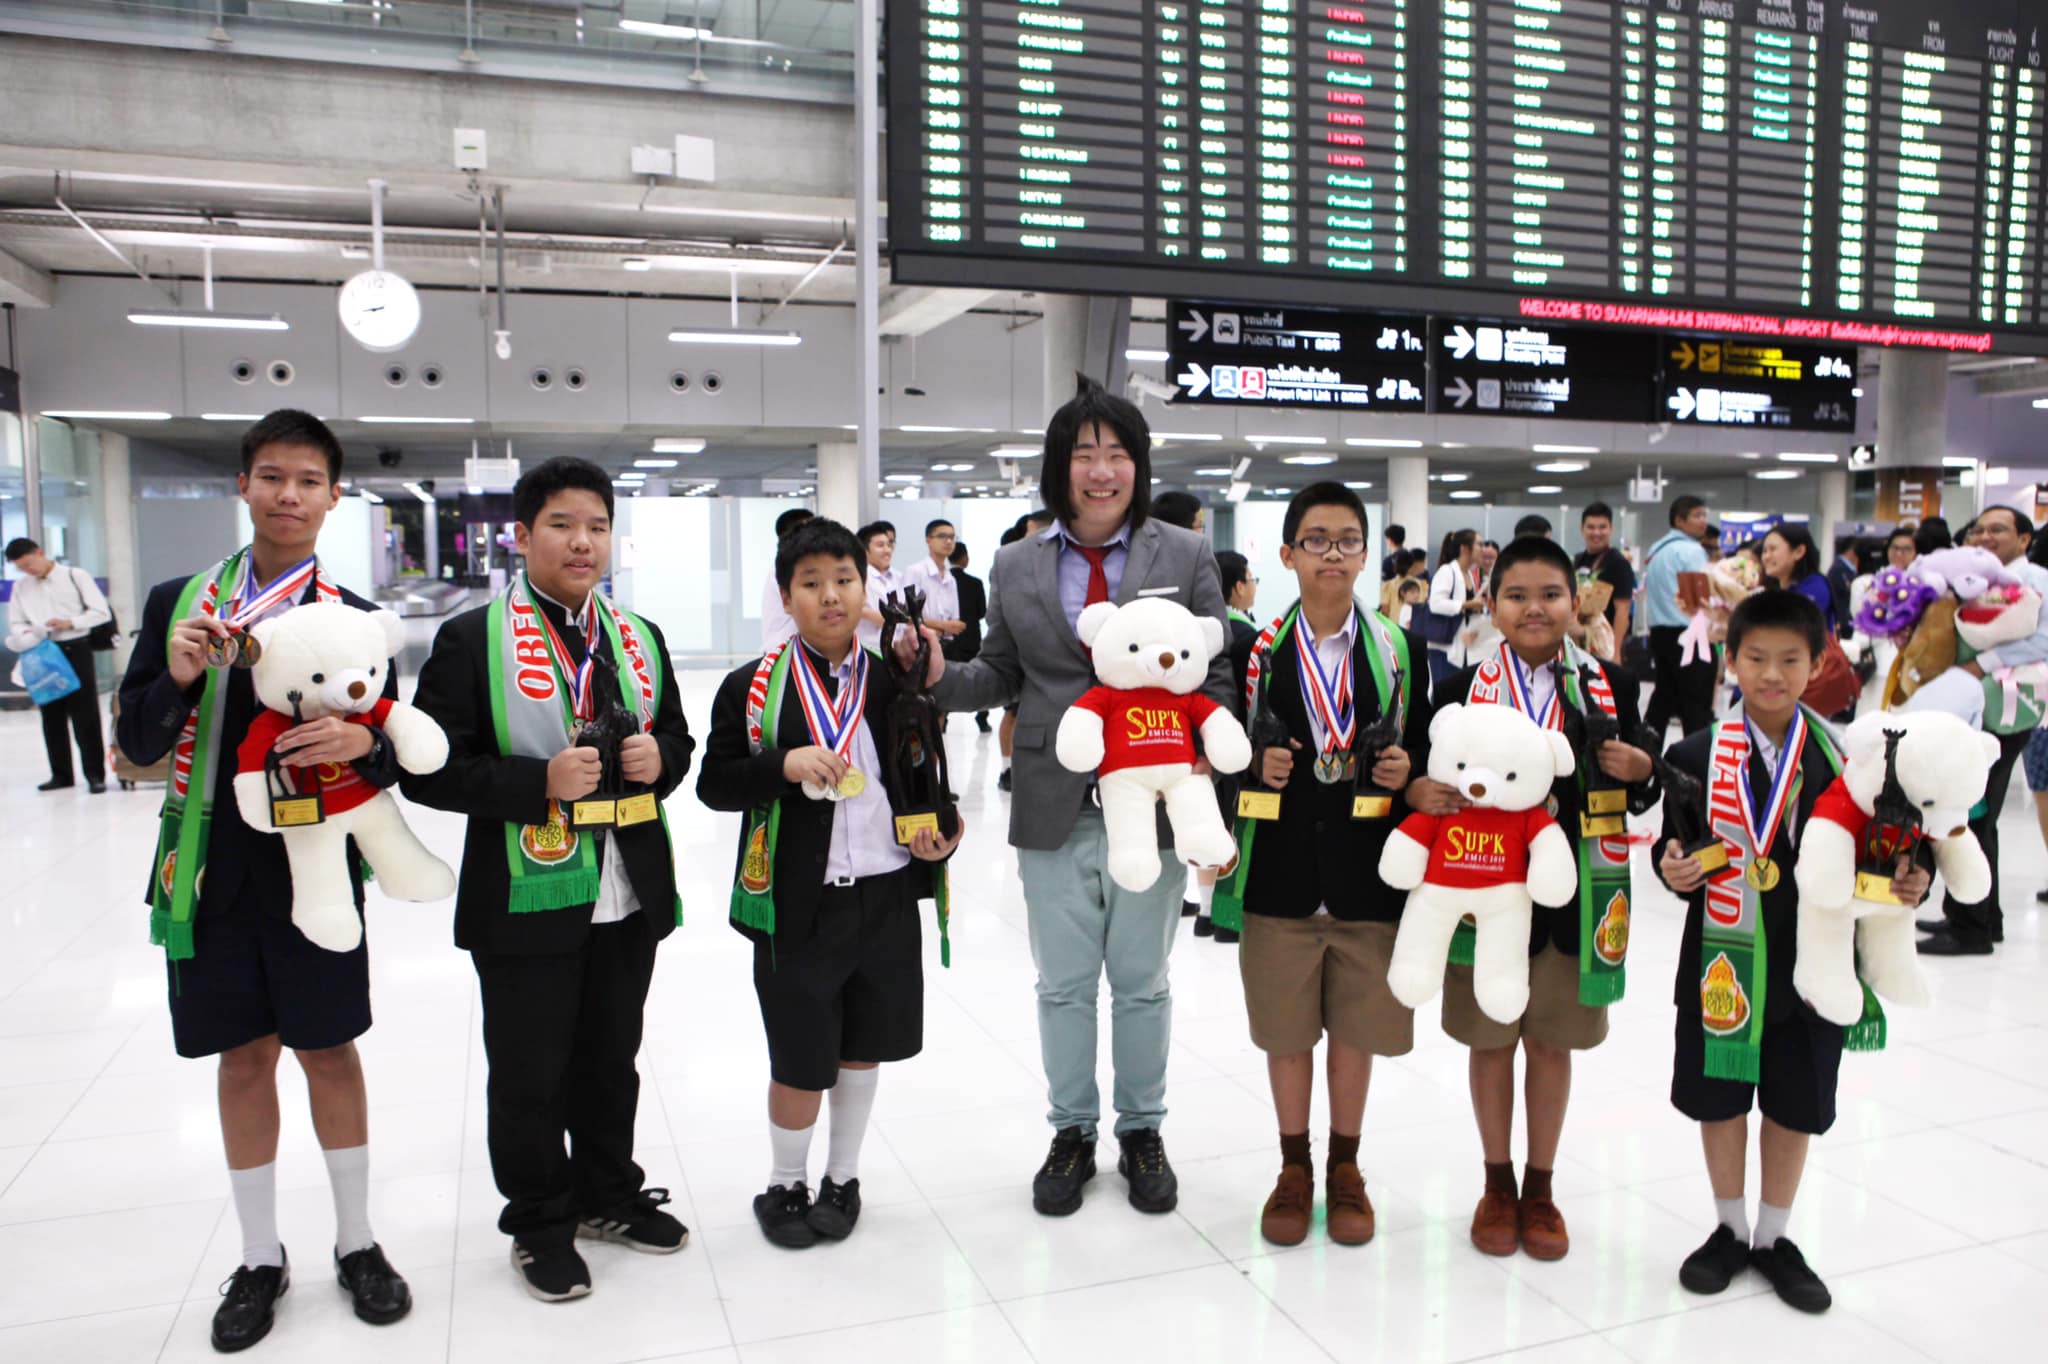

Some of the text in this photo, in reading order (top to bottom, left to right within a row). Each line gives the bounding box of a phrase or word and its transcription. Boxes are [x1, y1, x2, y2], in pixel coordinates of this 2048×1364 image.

[1756, 8, 1796, 29] REMARKS
[1807, 16, 1823, 32] EXIT
[1851, 23, 1868, 41] TIME
[1923, 34, 1945, 52] FROM
[1988, 45, 2014, 62] FLIGHT
[1520, 298, 1583, 320] WELCOME
[1584, 304, 1602, 321] TO
[1695, 311, 1780, 335] INTERNATIONAL
[1783, 317, 1829, 339] AIRPORT
[1243, 333, 1295, 348] Public Taxi
[1126, 706, 1181, 739] SUP'K
[1444, 825, 1505, 861] SUP'K
